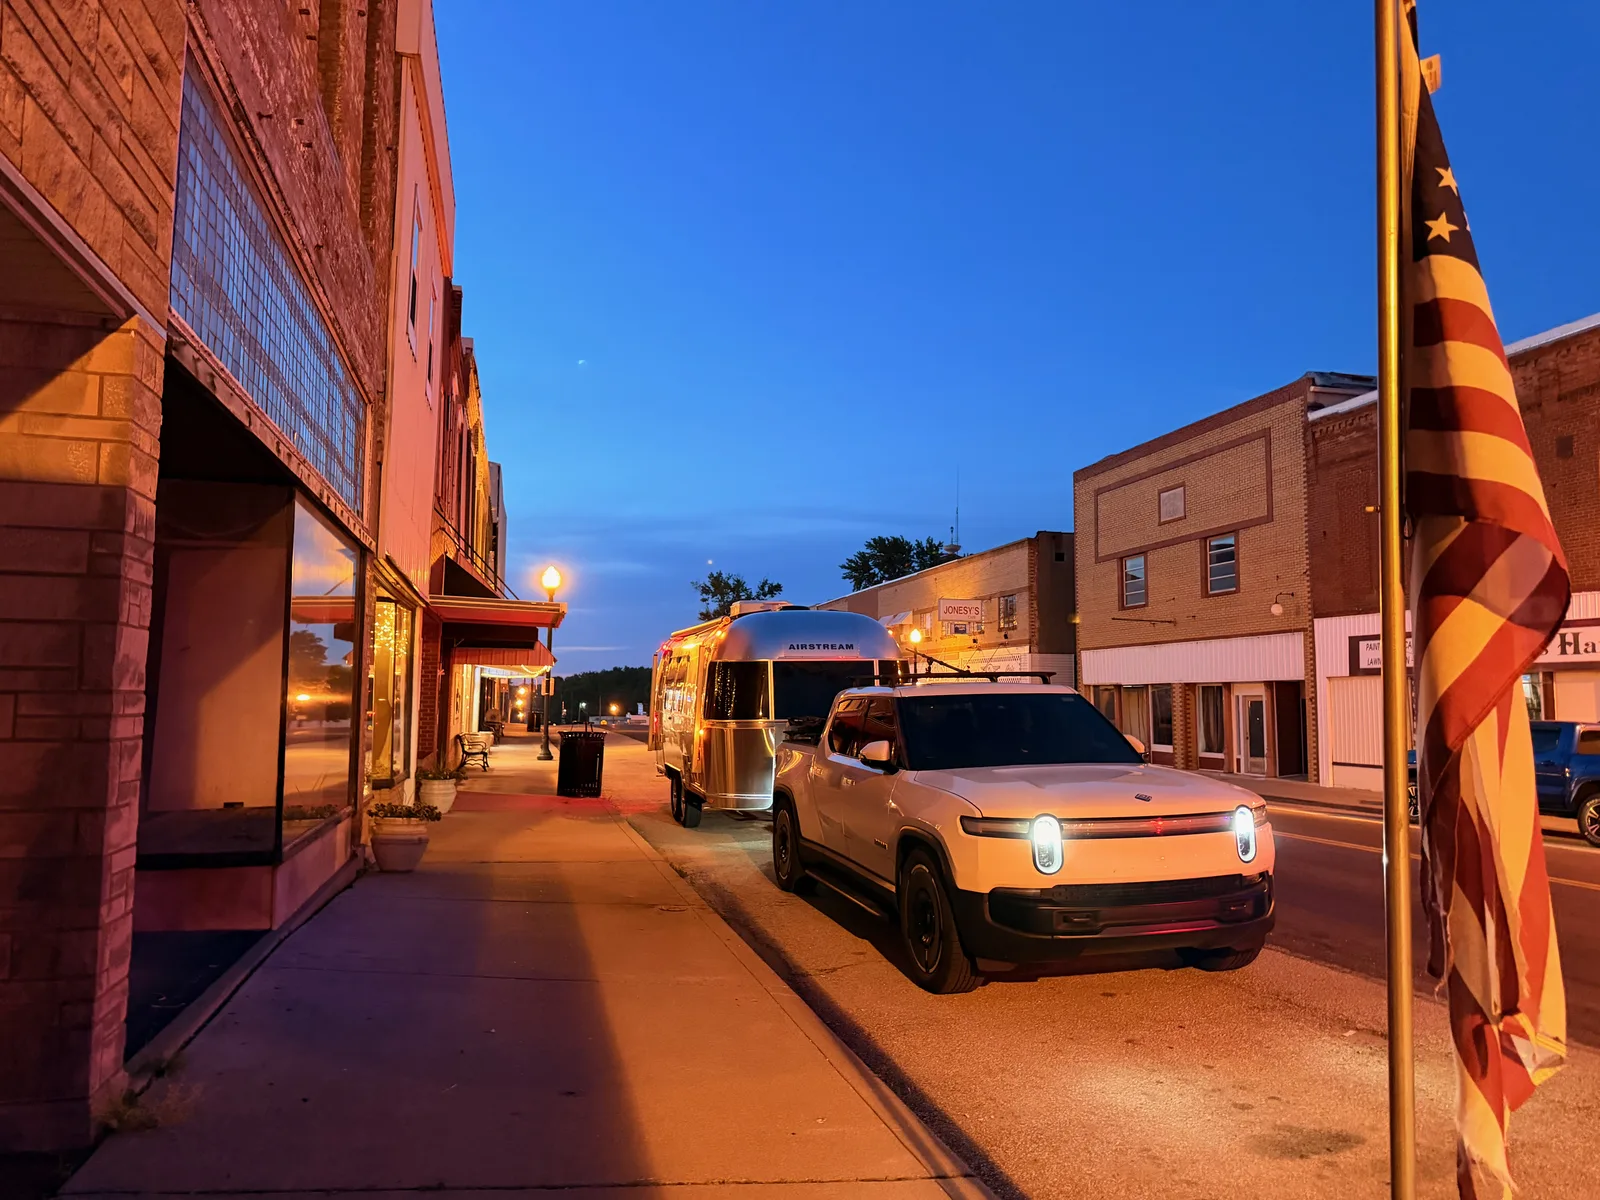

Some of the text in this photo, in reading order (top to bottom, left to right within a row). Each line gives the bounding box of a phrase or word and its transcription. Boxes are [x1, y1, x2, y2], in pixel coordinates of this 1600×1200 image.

[943, 605, 980, 616] JONESY'S
[788, 643, 854, 651] AIRSTREAM
[1557, 631, 1600, 656] Ha
